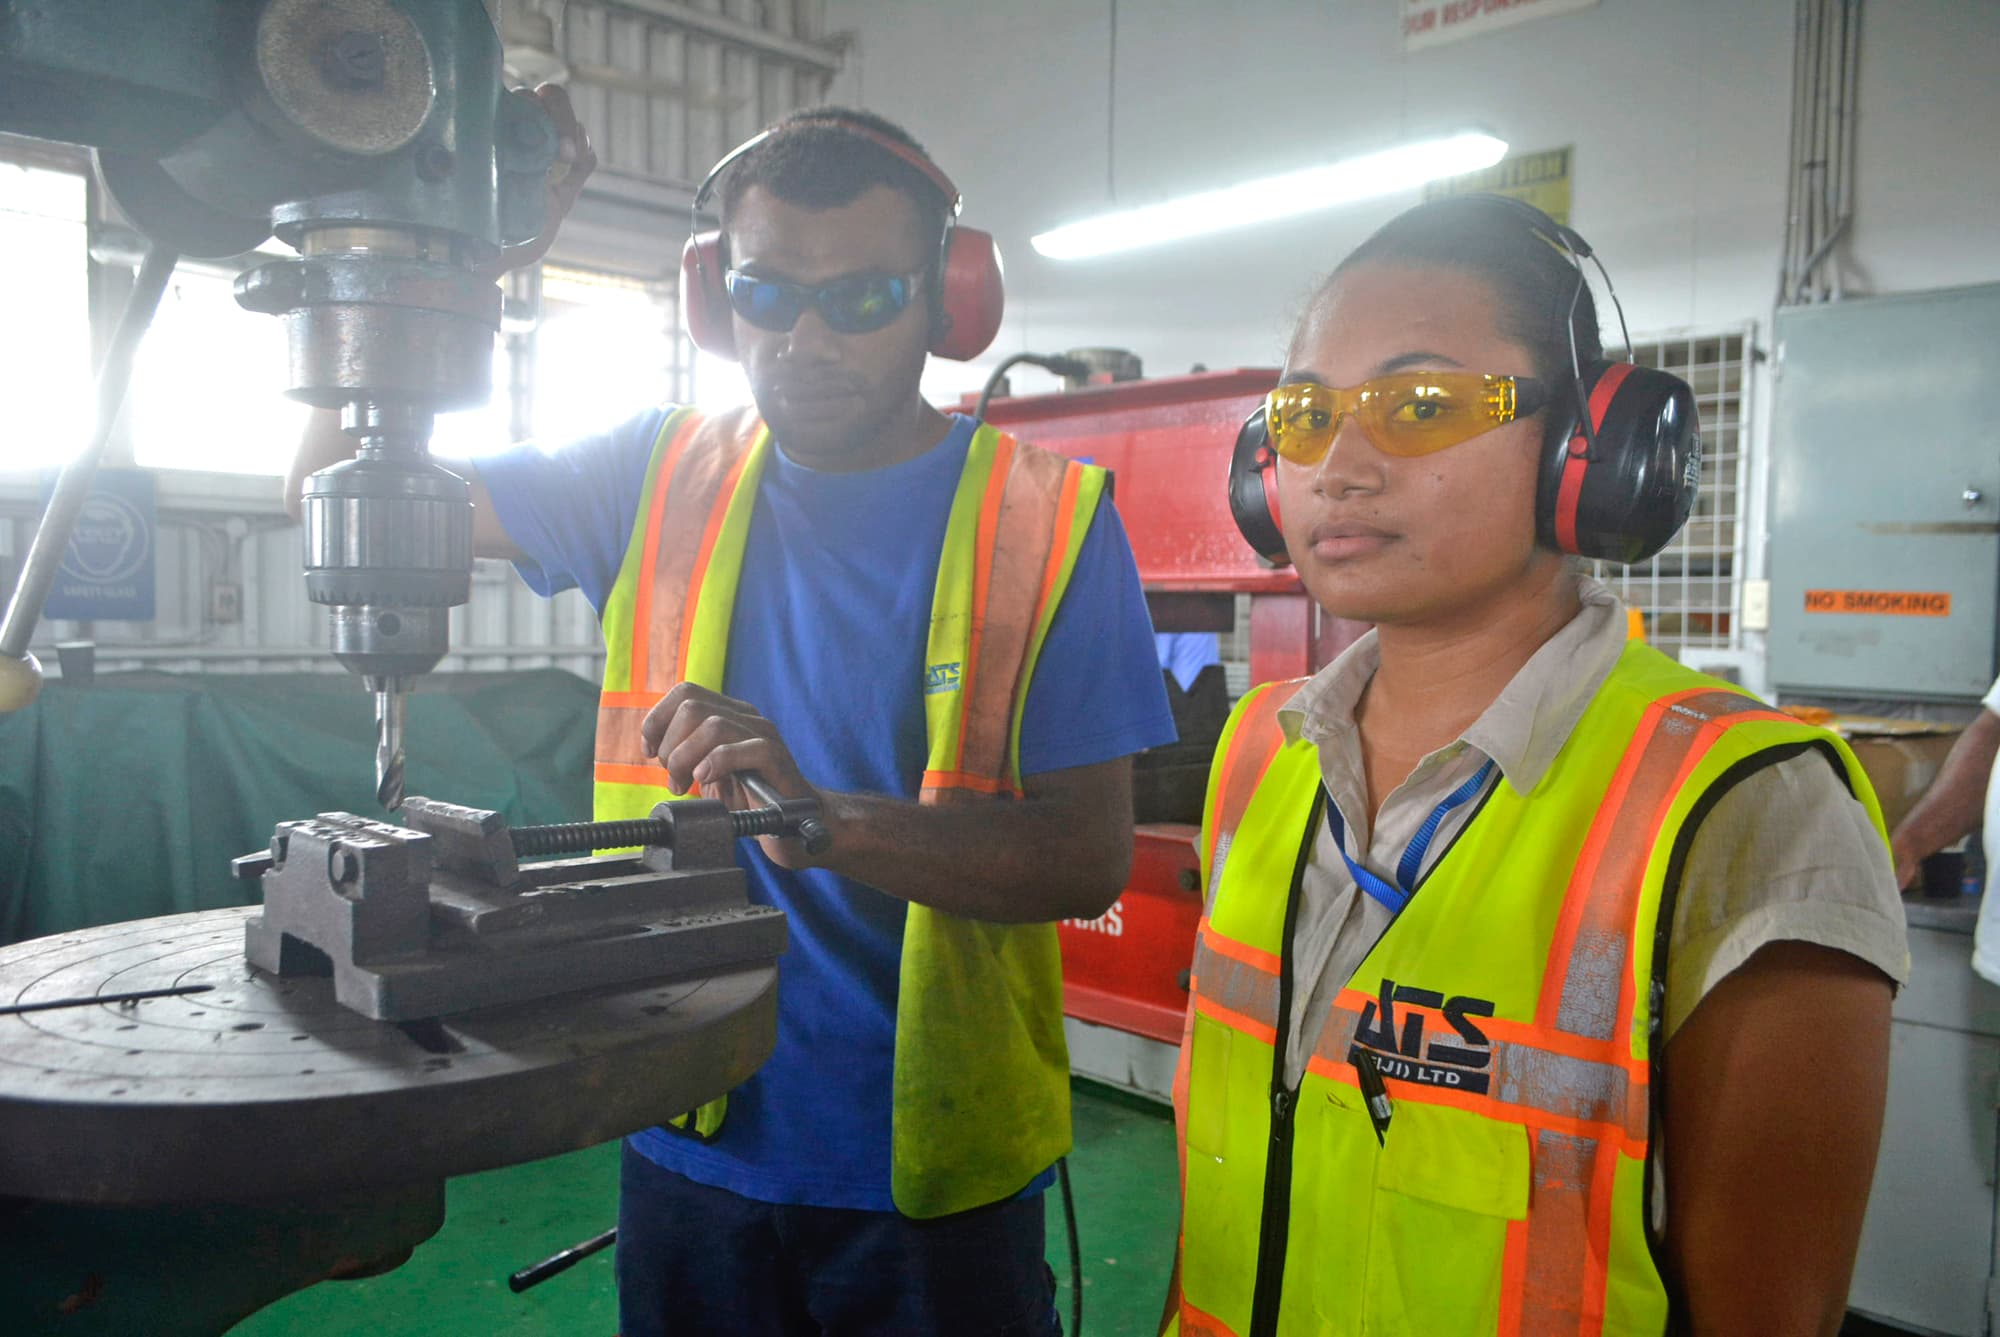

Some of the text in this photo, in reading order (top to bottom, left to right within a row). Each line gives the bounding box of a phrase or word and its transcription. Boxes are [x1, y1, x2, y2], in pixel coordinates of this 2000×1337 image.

[1805, 591, 1946, 612] NO SMOKING
[1353, 978, 1495, 1069] ATS
[1417, 1067, 1461, 1085] LTD
